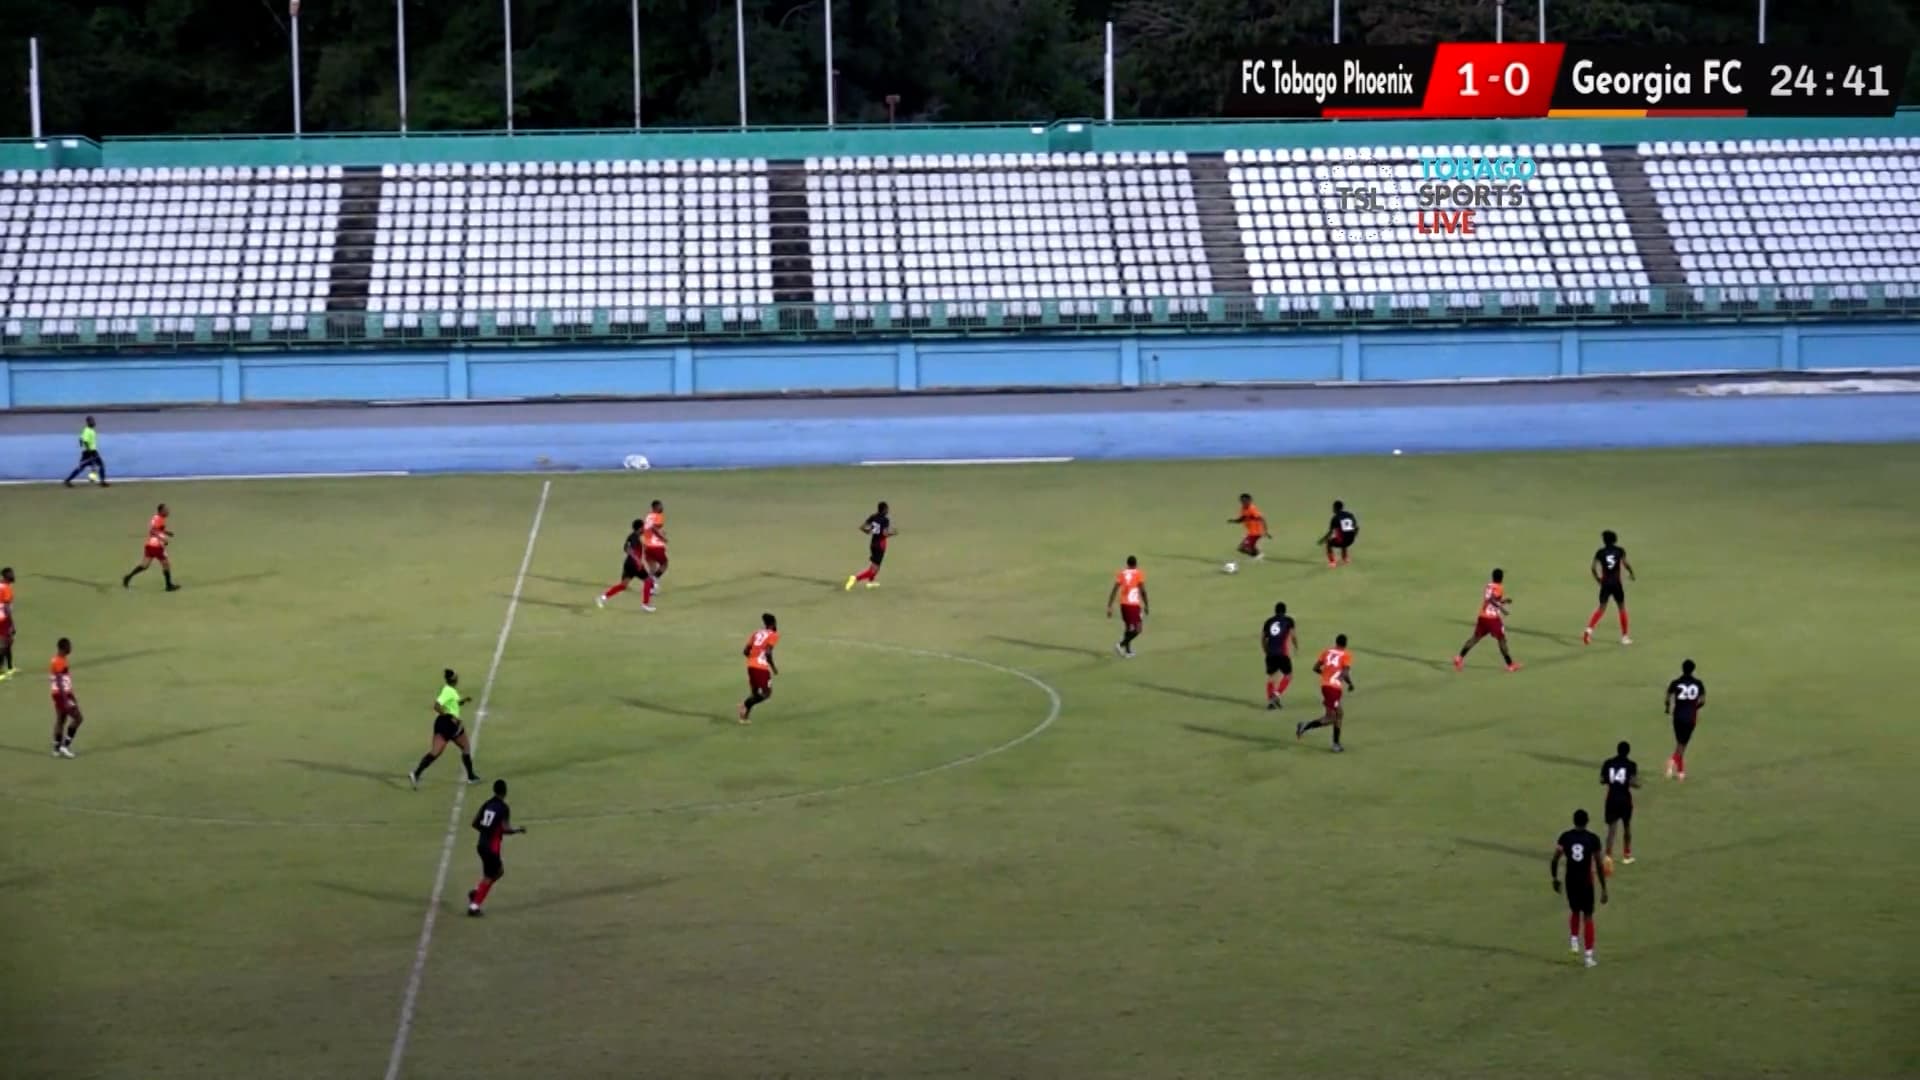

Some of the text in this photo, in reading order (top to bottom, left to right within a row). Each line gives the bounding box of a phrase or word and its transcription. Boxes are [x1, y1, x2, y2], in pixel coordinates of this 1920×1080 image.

[1605, 554, 1616, 569] 5
[1270, 621, 1281, 636] 6
[1676, 683, 1699, 700] 20
[1608, 767, 1627, 784] 14
[1571, 842, 1584, 861] 8
